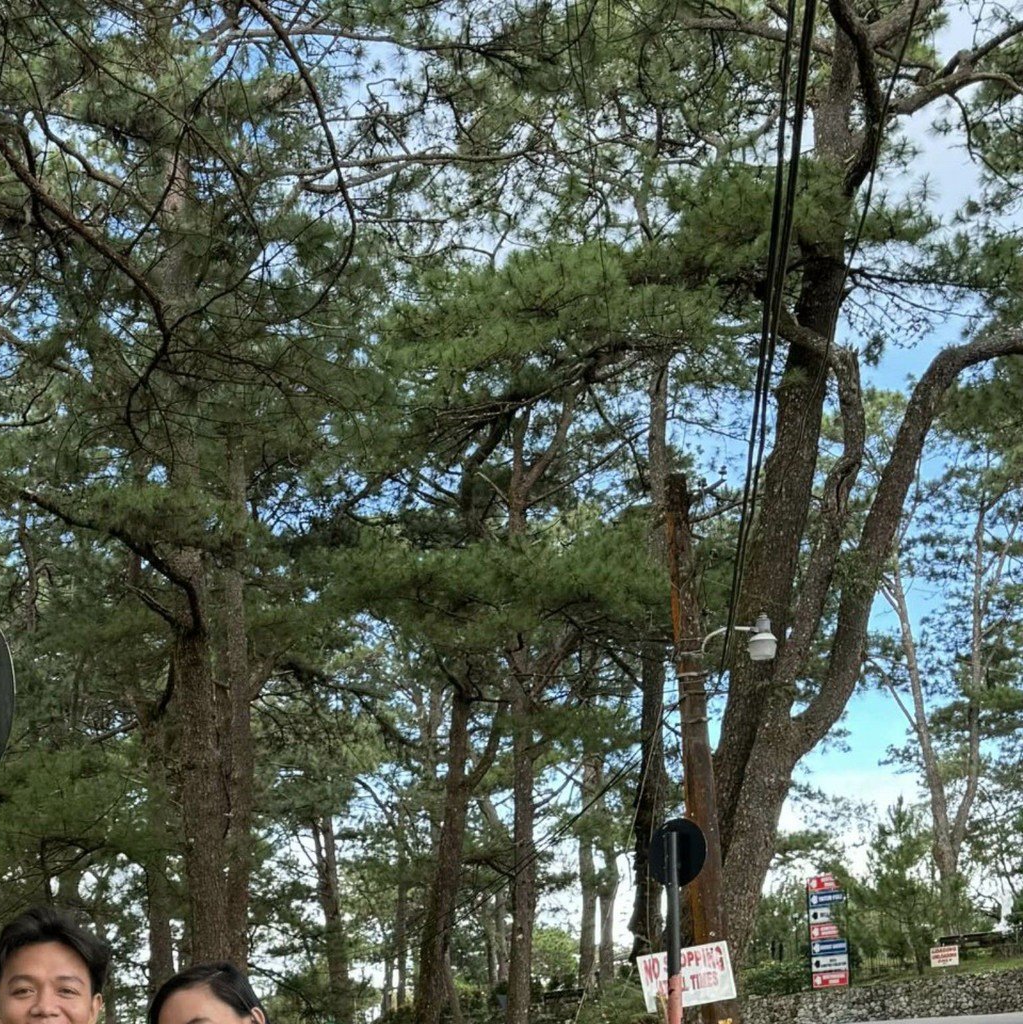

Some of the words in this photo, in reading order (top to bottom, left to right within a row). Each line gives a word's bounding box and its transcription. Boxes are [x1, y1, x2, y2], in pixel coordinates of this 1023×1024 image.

[642, 957, 660, 986] NO
[663, 945, 725, 972] SOPPING
[689, 971, 719, 990] TIMES
